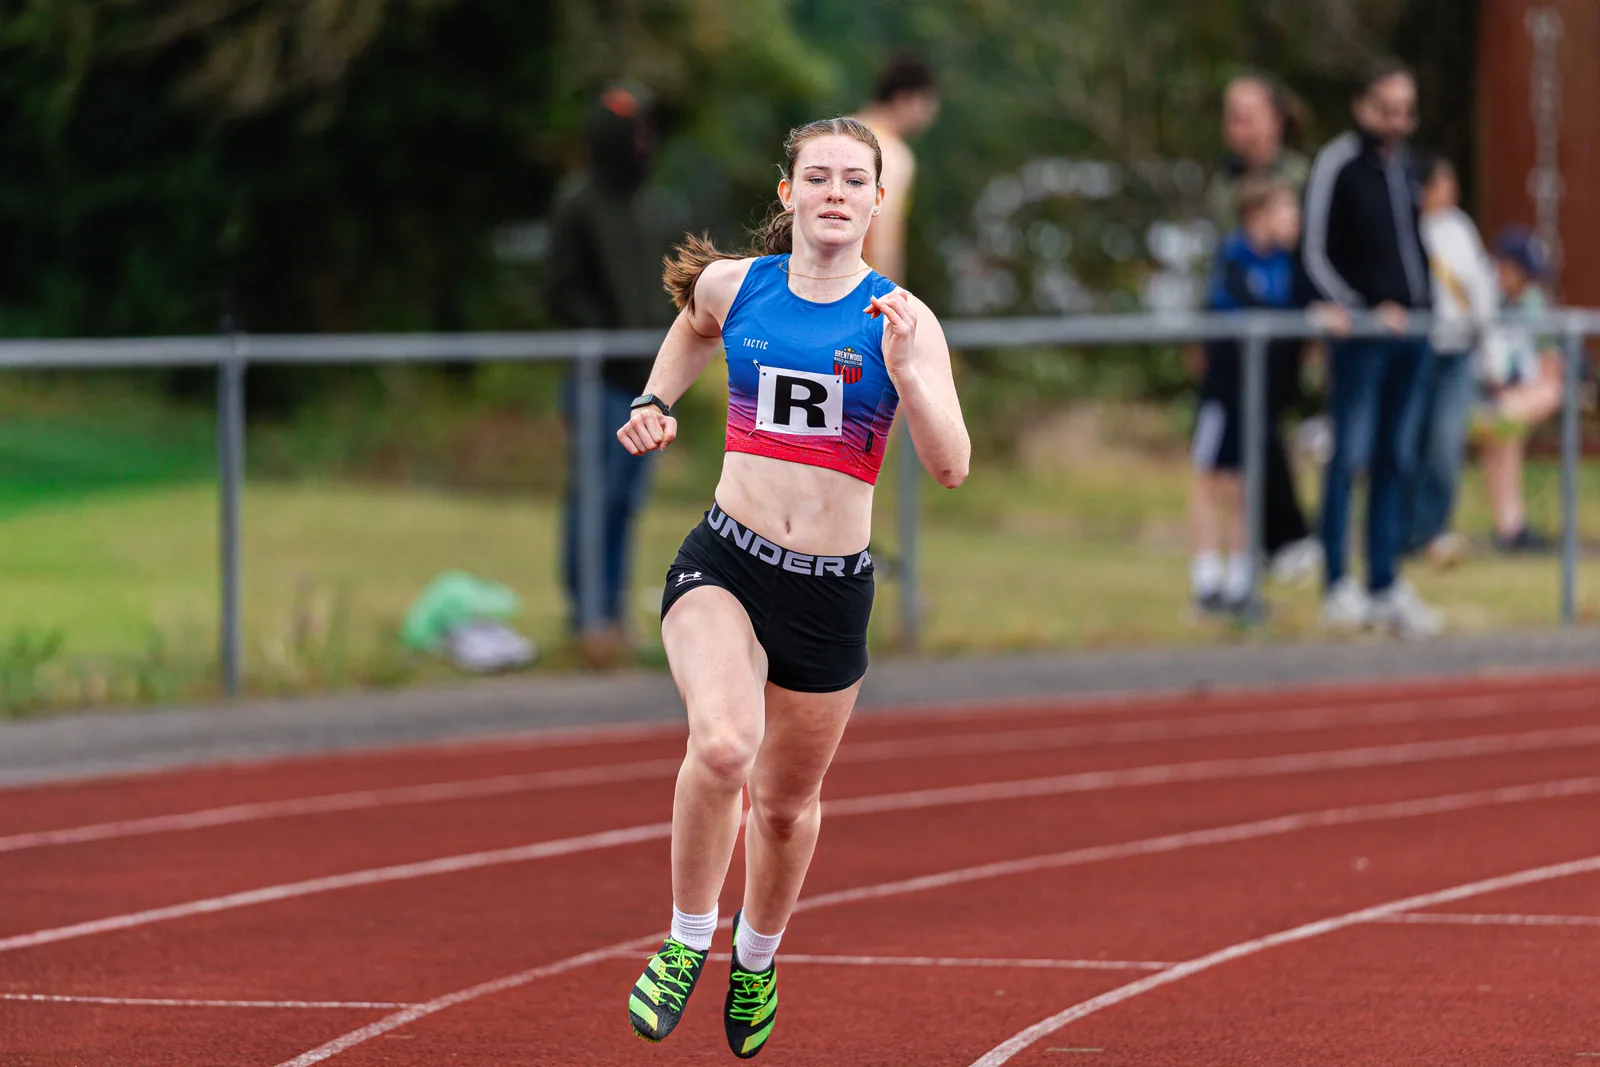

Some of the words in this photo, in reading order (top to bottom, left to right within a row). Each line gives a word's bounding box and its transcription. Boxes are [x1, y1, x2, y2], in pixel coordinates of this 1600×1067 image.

[743, 337, 769, 350] TACTIC
[834, 349, 863, 362] BRENTWOOD
[773, 374, 828, 428] R
[707, 501, 845, 577] UNDER
